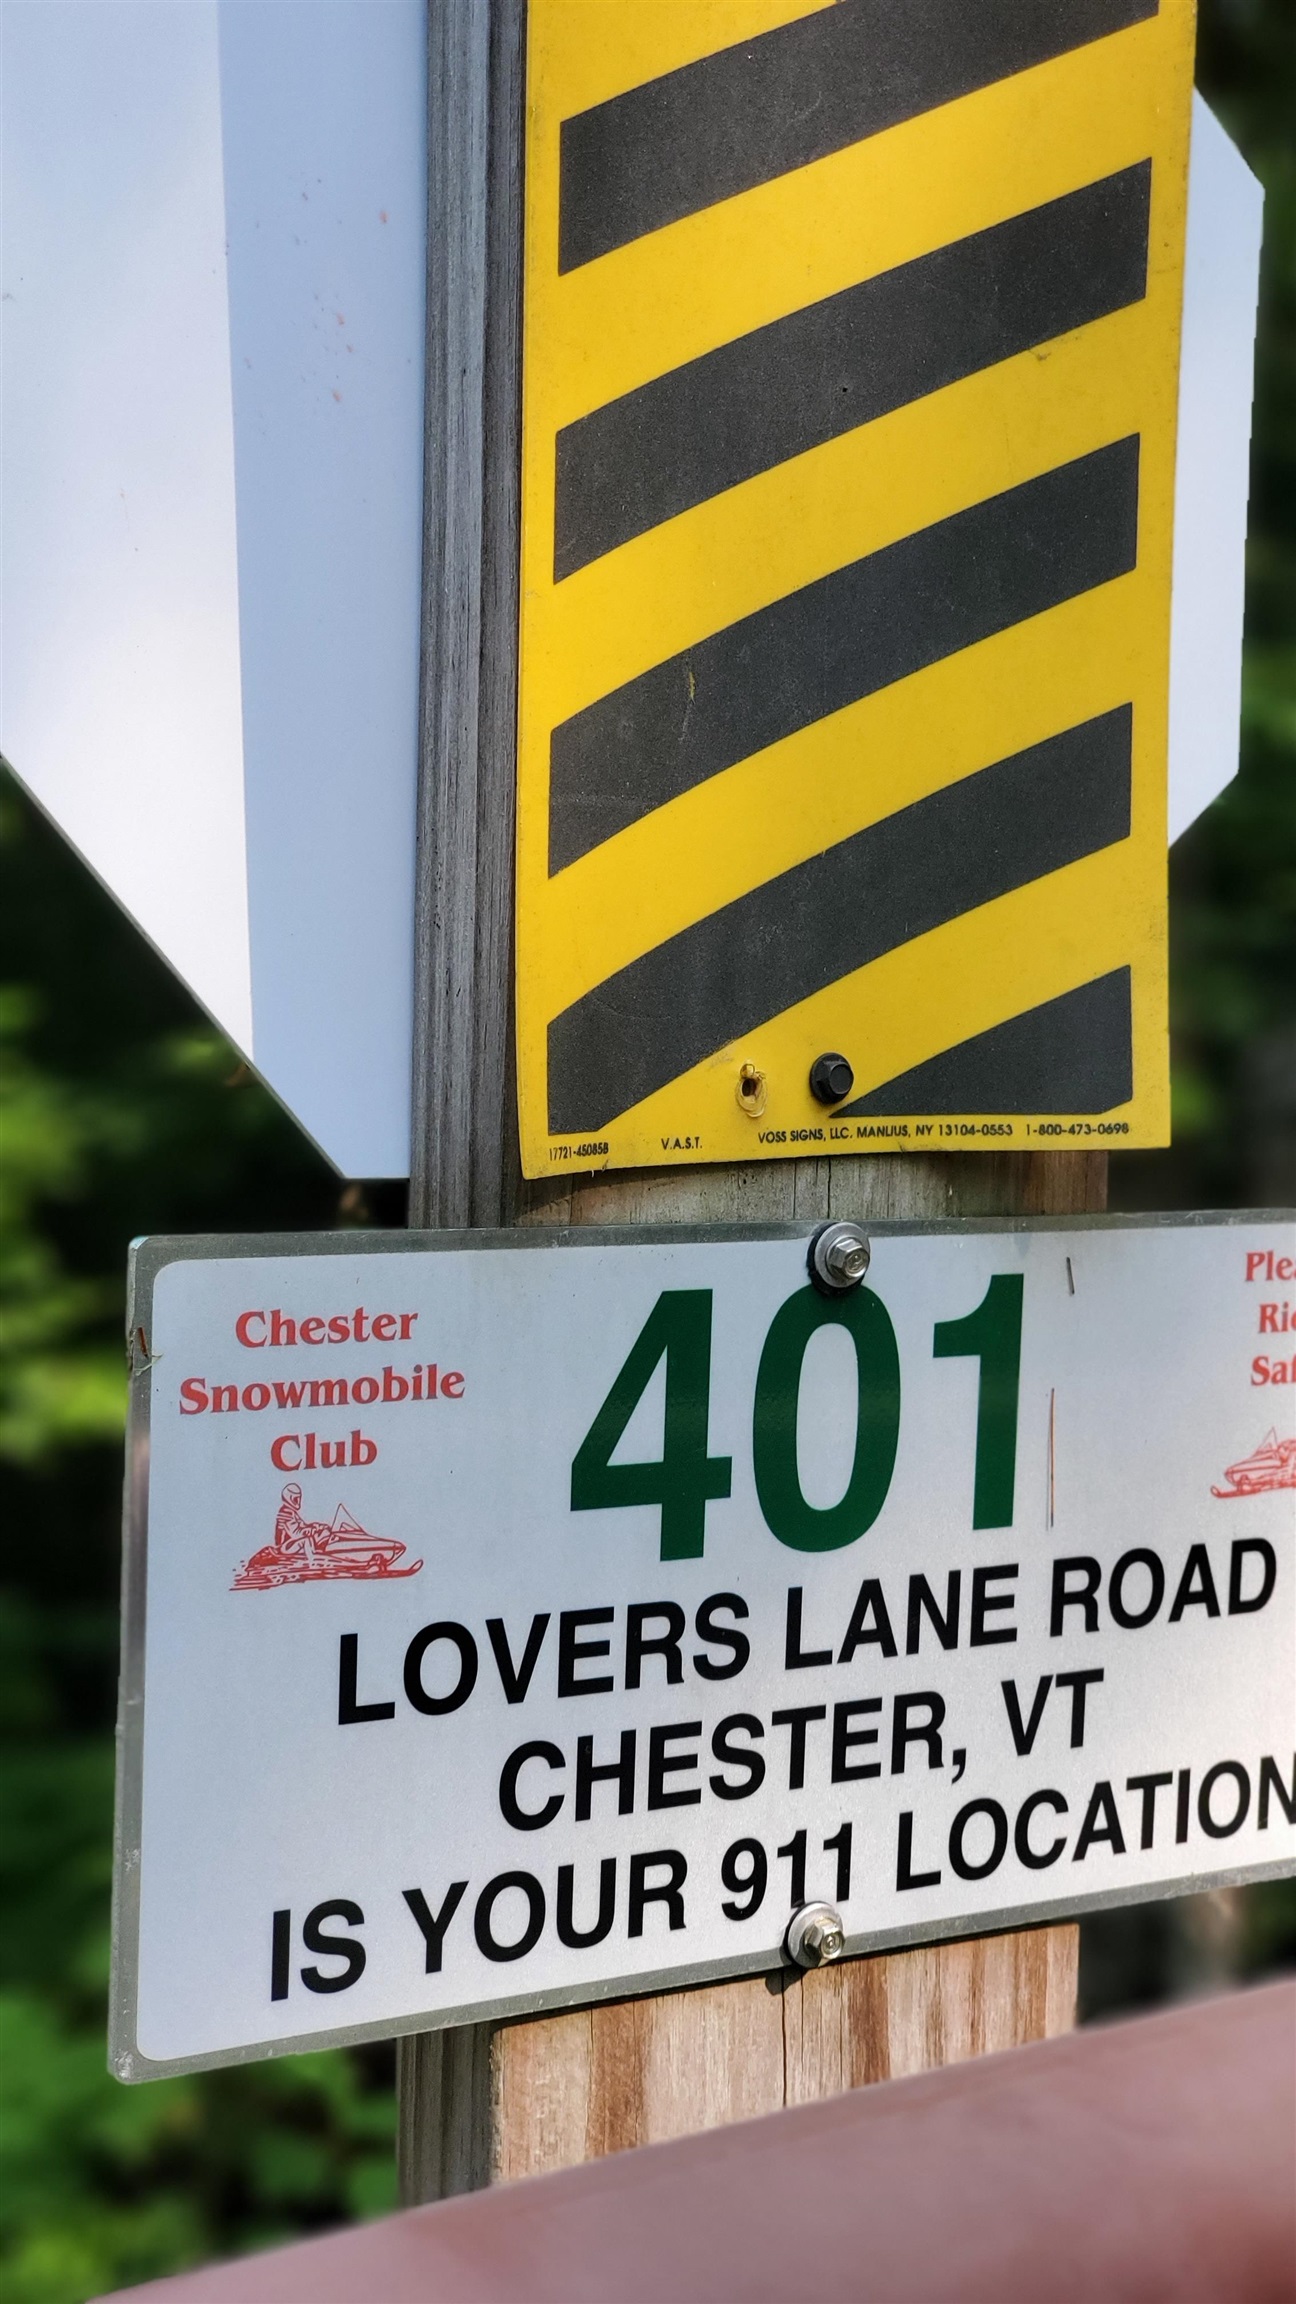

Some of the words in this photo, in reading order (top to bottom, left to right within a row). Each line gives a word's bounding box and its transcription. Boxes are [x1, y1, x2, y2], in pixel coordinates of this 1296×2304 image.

[661, 1136, 703, 1150] V.A.S.T.
[758, 1130, 787, 1144] VOSS
[790, 1128, 826, 1142] SIGNS,
[857, 1124, 911, 1139] MANLIUS,
[915, 1124, 934, 1136] NY
[939, 1123, 1013, 1136] 13104-0553
[1026, 1122, 1130, 1136] 1-800-473-0698
[235, 1307, 418, 1348] Chester
[180, 1363, 465, 1415] Snowmobile
[570, 1273, 1025, 1563] 401
[270, 1430, 378, 1472] Club
[338, 1591, 751, 1726] LOVERS
[784, 1563, 1020, 1671] LANE
[1049, 1537, 1277, 1638] ROAD
[499, 1690, 967, 1832] CHESTER,
[1000, 1667, 1105, 1757] VT
[270, 1898, 367, 2002] IS
[401, 1849, 688, 1975] YOUR
[720, 1822, 853, 1922] 911
[895, 1752, 1296, 1892] LOCATION
